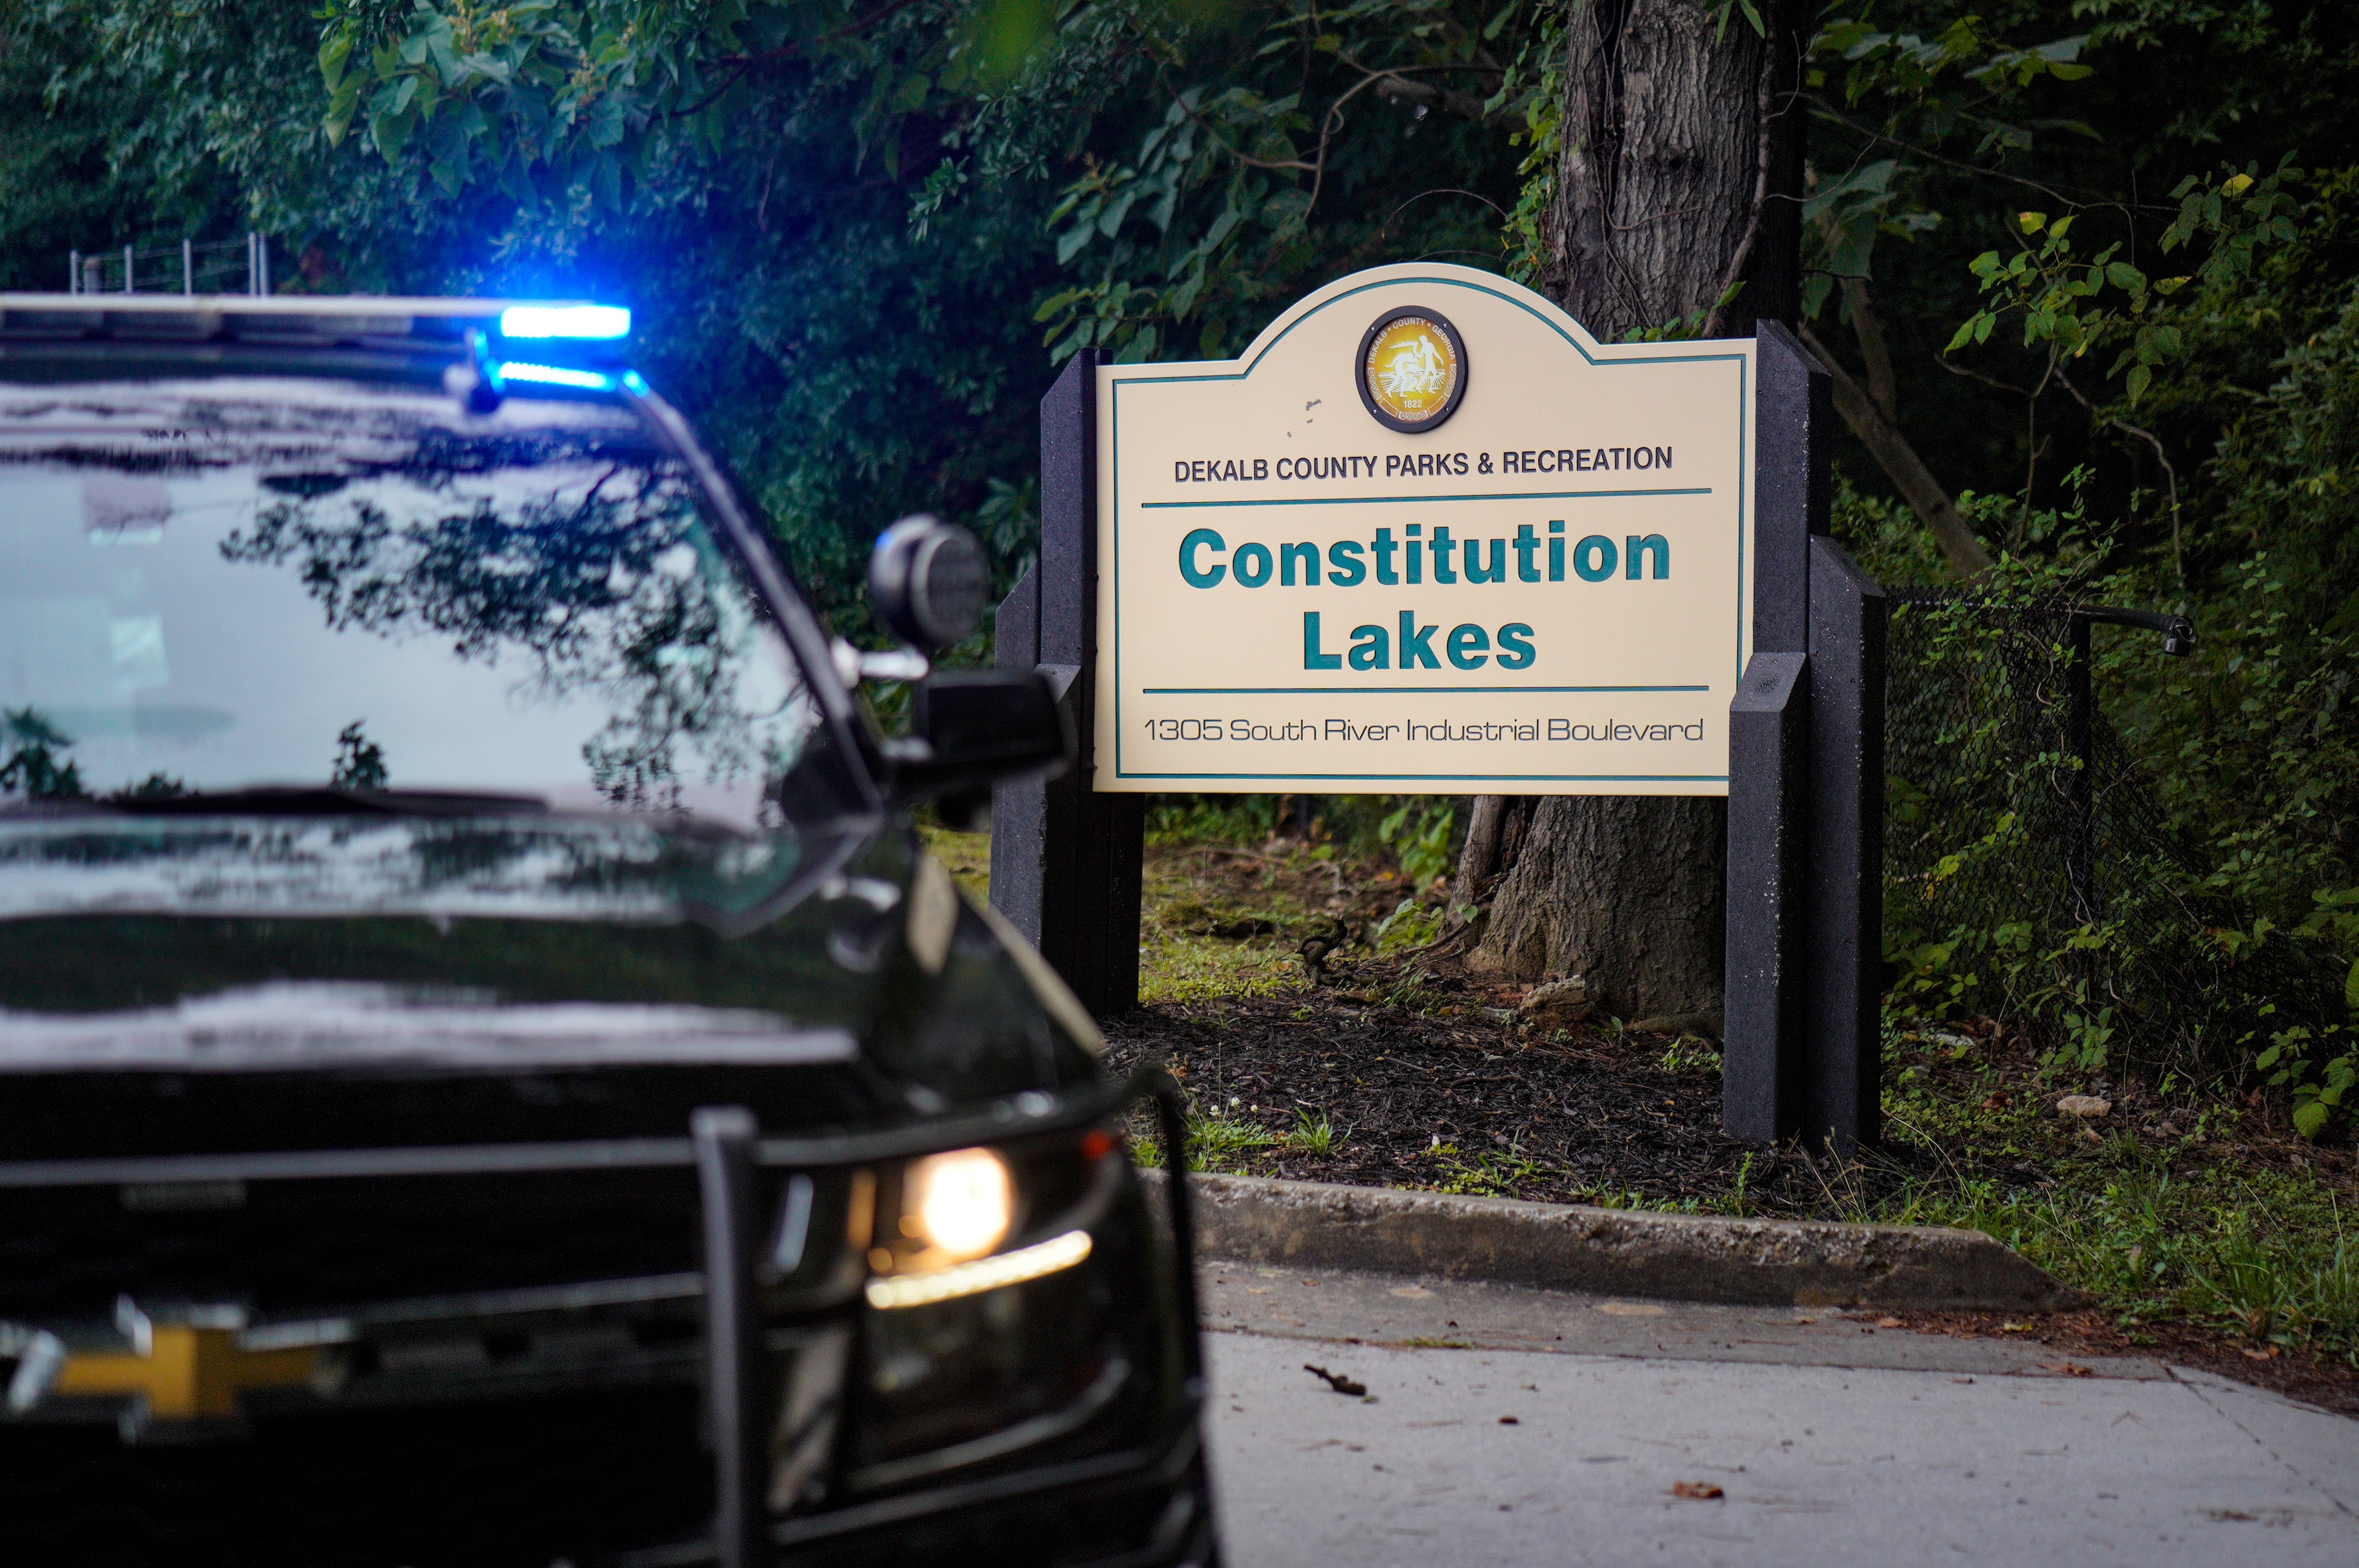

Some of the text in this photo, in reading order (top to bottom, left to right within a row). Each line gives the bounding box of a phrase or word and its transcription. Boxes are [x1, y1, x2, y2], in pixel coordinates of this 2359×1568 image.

[1368, 318, 1456, 364] DEKALB COUNTY GEORGIA
[1403, 400, 1422, 408] 1822
[1175, 447, 1672, 482] DEKALB COUNTY PARKS & RECREATION
[1179, 520, 1669, 588] Constitution
[1304, 610, 1536, 671] Lakes
[1145, 719, 1703, 741] 1305 South River Industrial Boulevard
